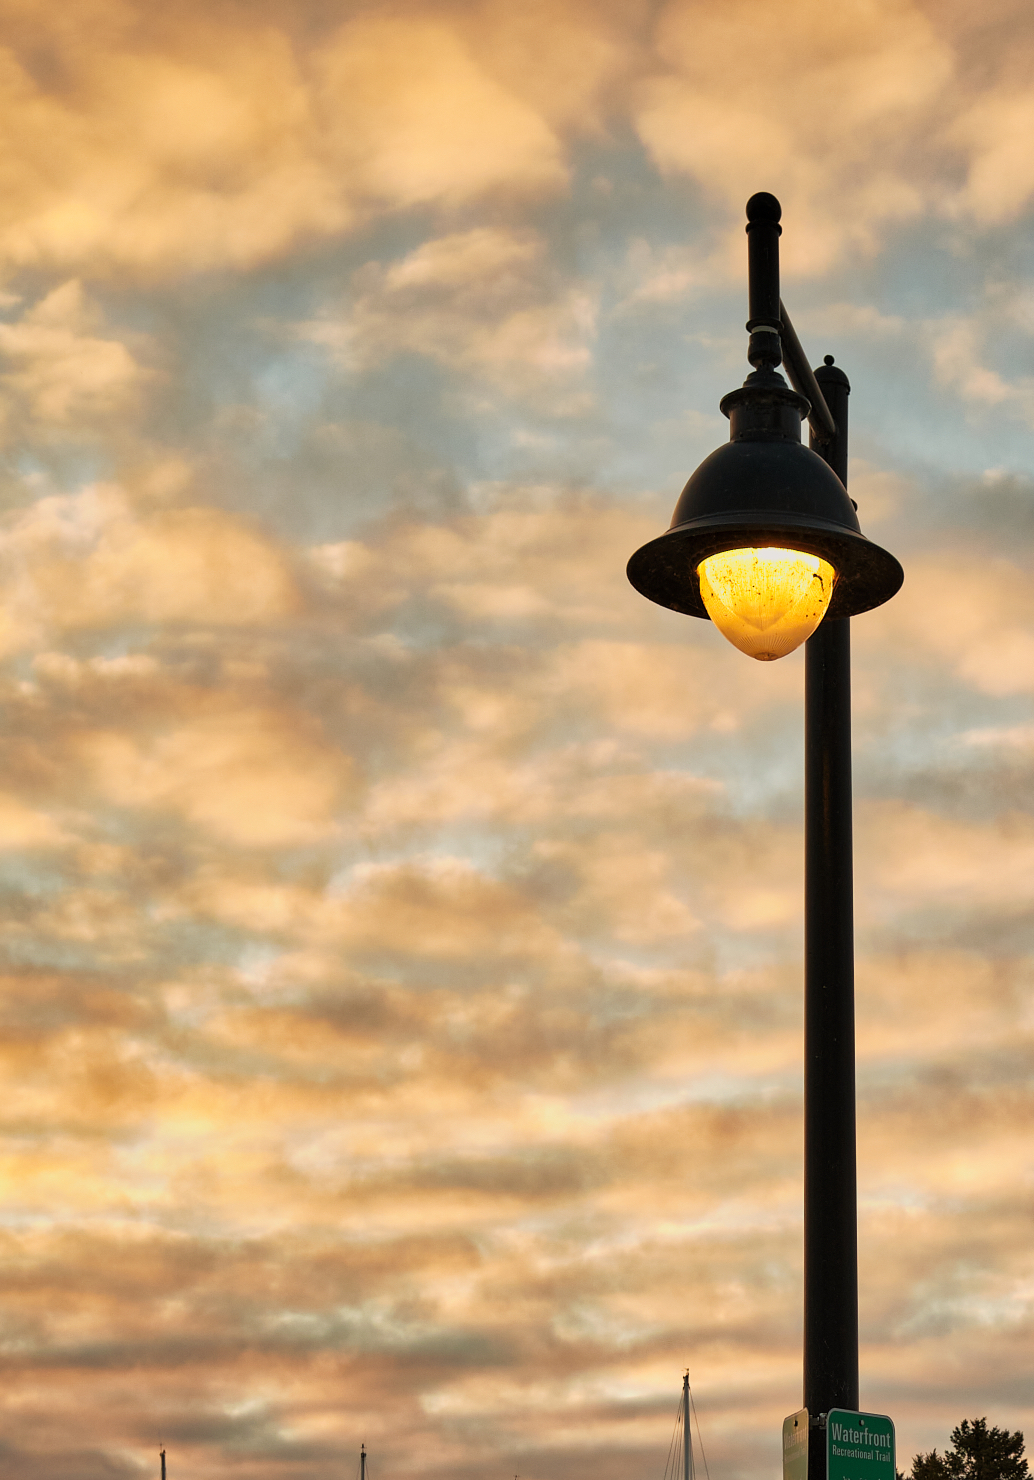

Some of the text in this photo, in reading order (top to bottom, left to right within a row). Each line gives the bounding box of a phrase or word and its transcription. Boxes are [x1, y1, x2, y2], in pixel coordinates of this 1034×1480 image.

[831, 1422, 891, 1448] Waterfront
[832, 1445, 891, 1463] Recreational Trail
